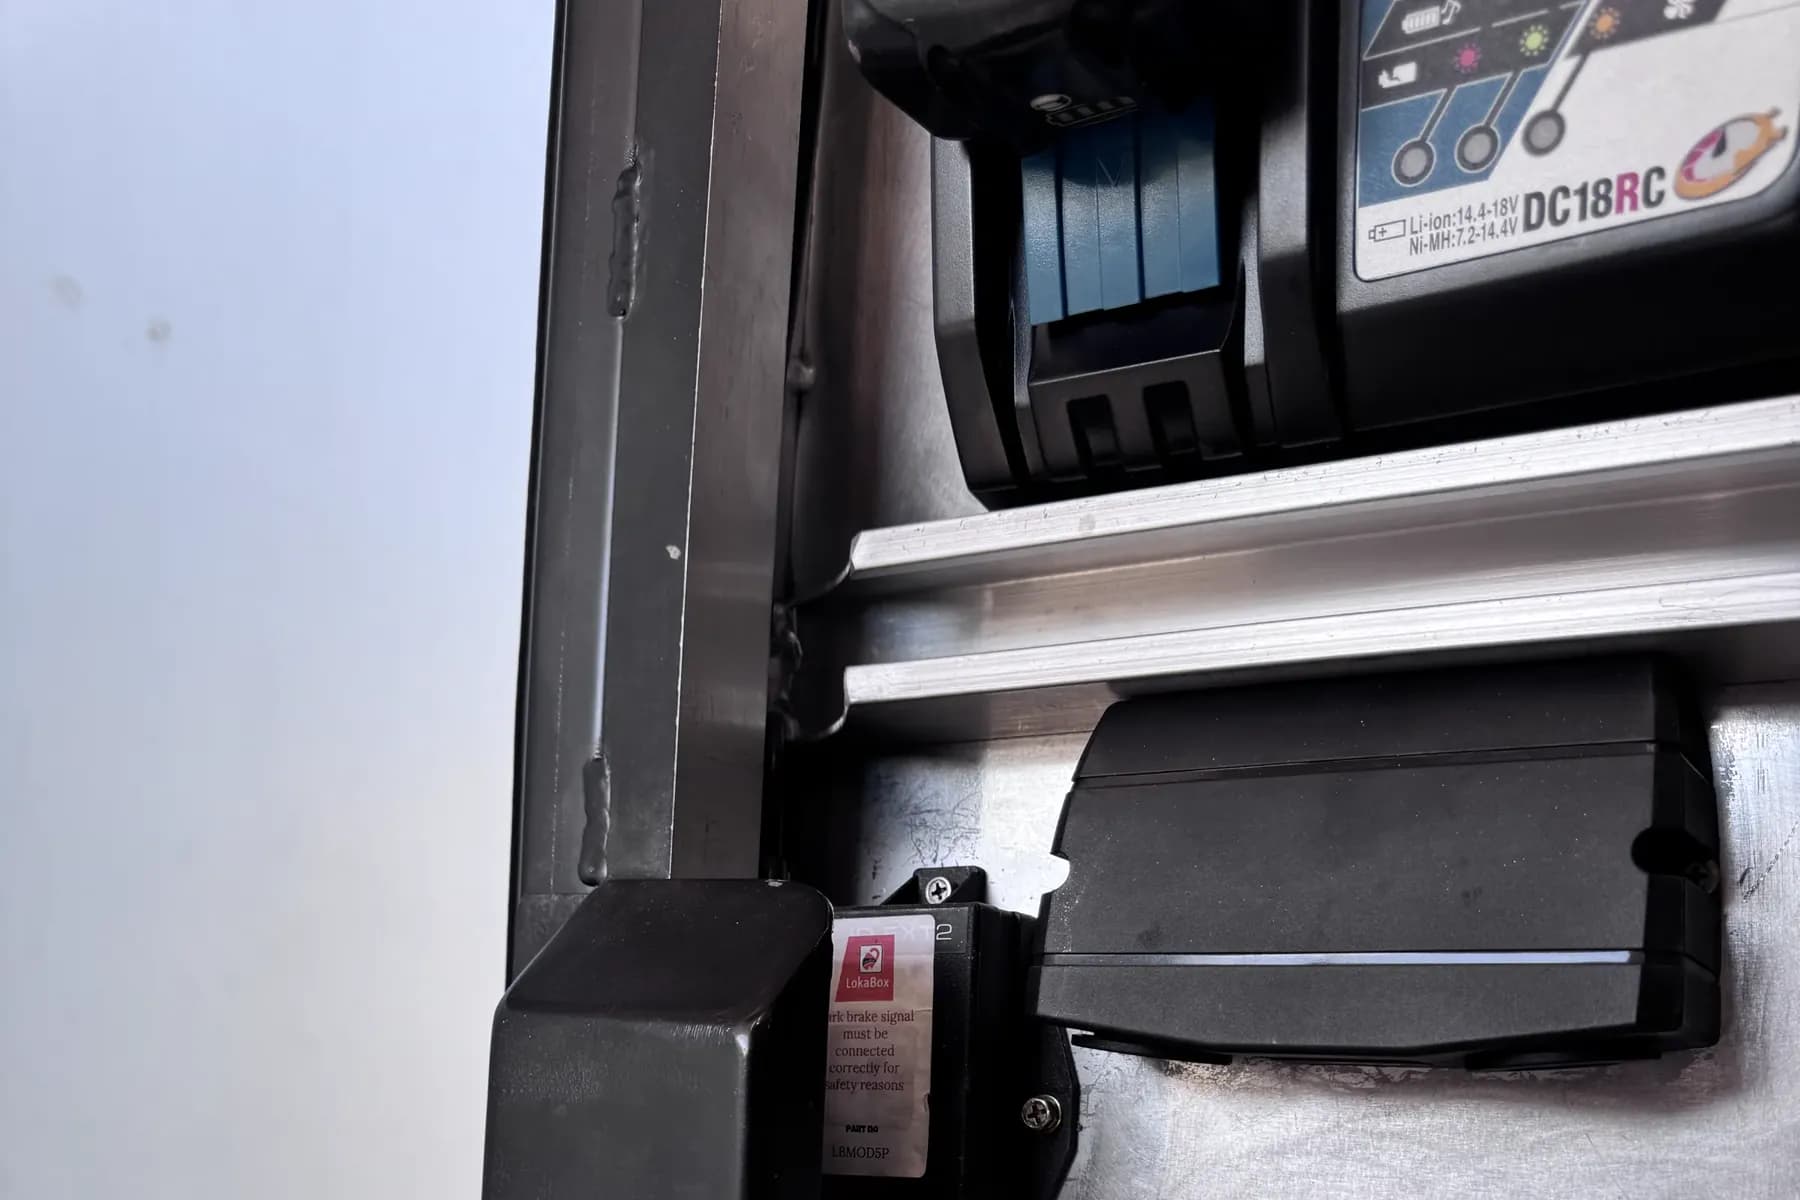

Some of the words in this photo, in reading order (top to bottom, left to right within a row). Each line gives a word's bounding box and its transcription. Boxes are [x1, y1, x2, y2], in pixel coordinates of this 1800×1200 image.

[1523, 165, 1666, 233] DC18RC
[846, 976, 889, 989] LokaBox
[846, 1010, 878, 1022] brake
[880, 1009, 914, 1025] signal
[843, 1029, 871, 1040] must
[874, 1027, 888, 1040] be
[835, 1044, 895, 1057] connected
[829, 1062, 880, 1077] correctly
[883, 1061, 900, 1073] for
[825, 1080, 857, 1094] safety
[859, 1081, 904, 1092] reasons
